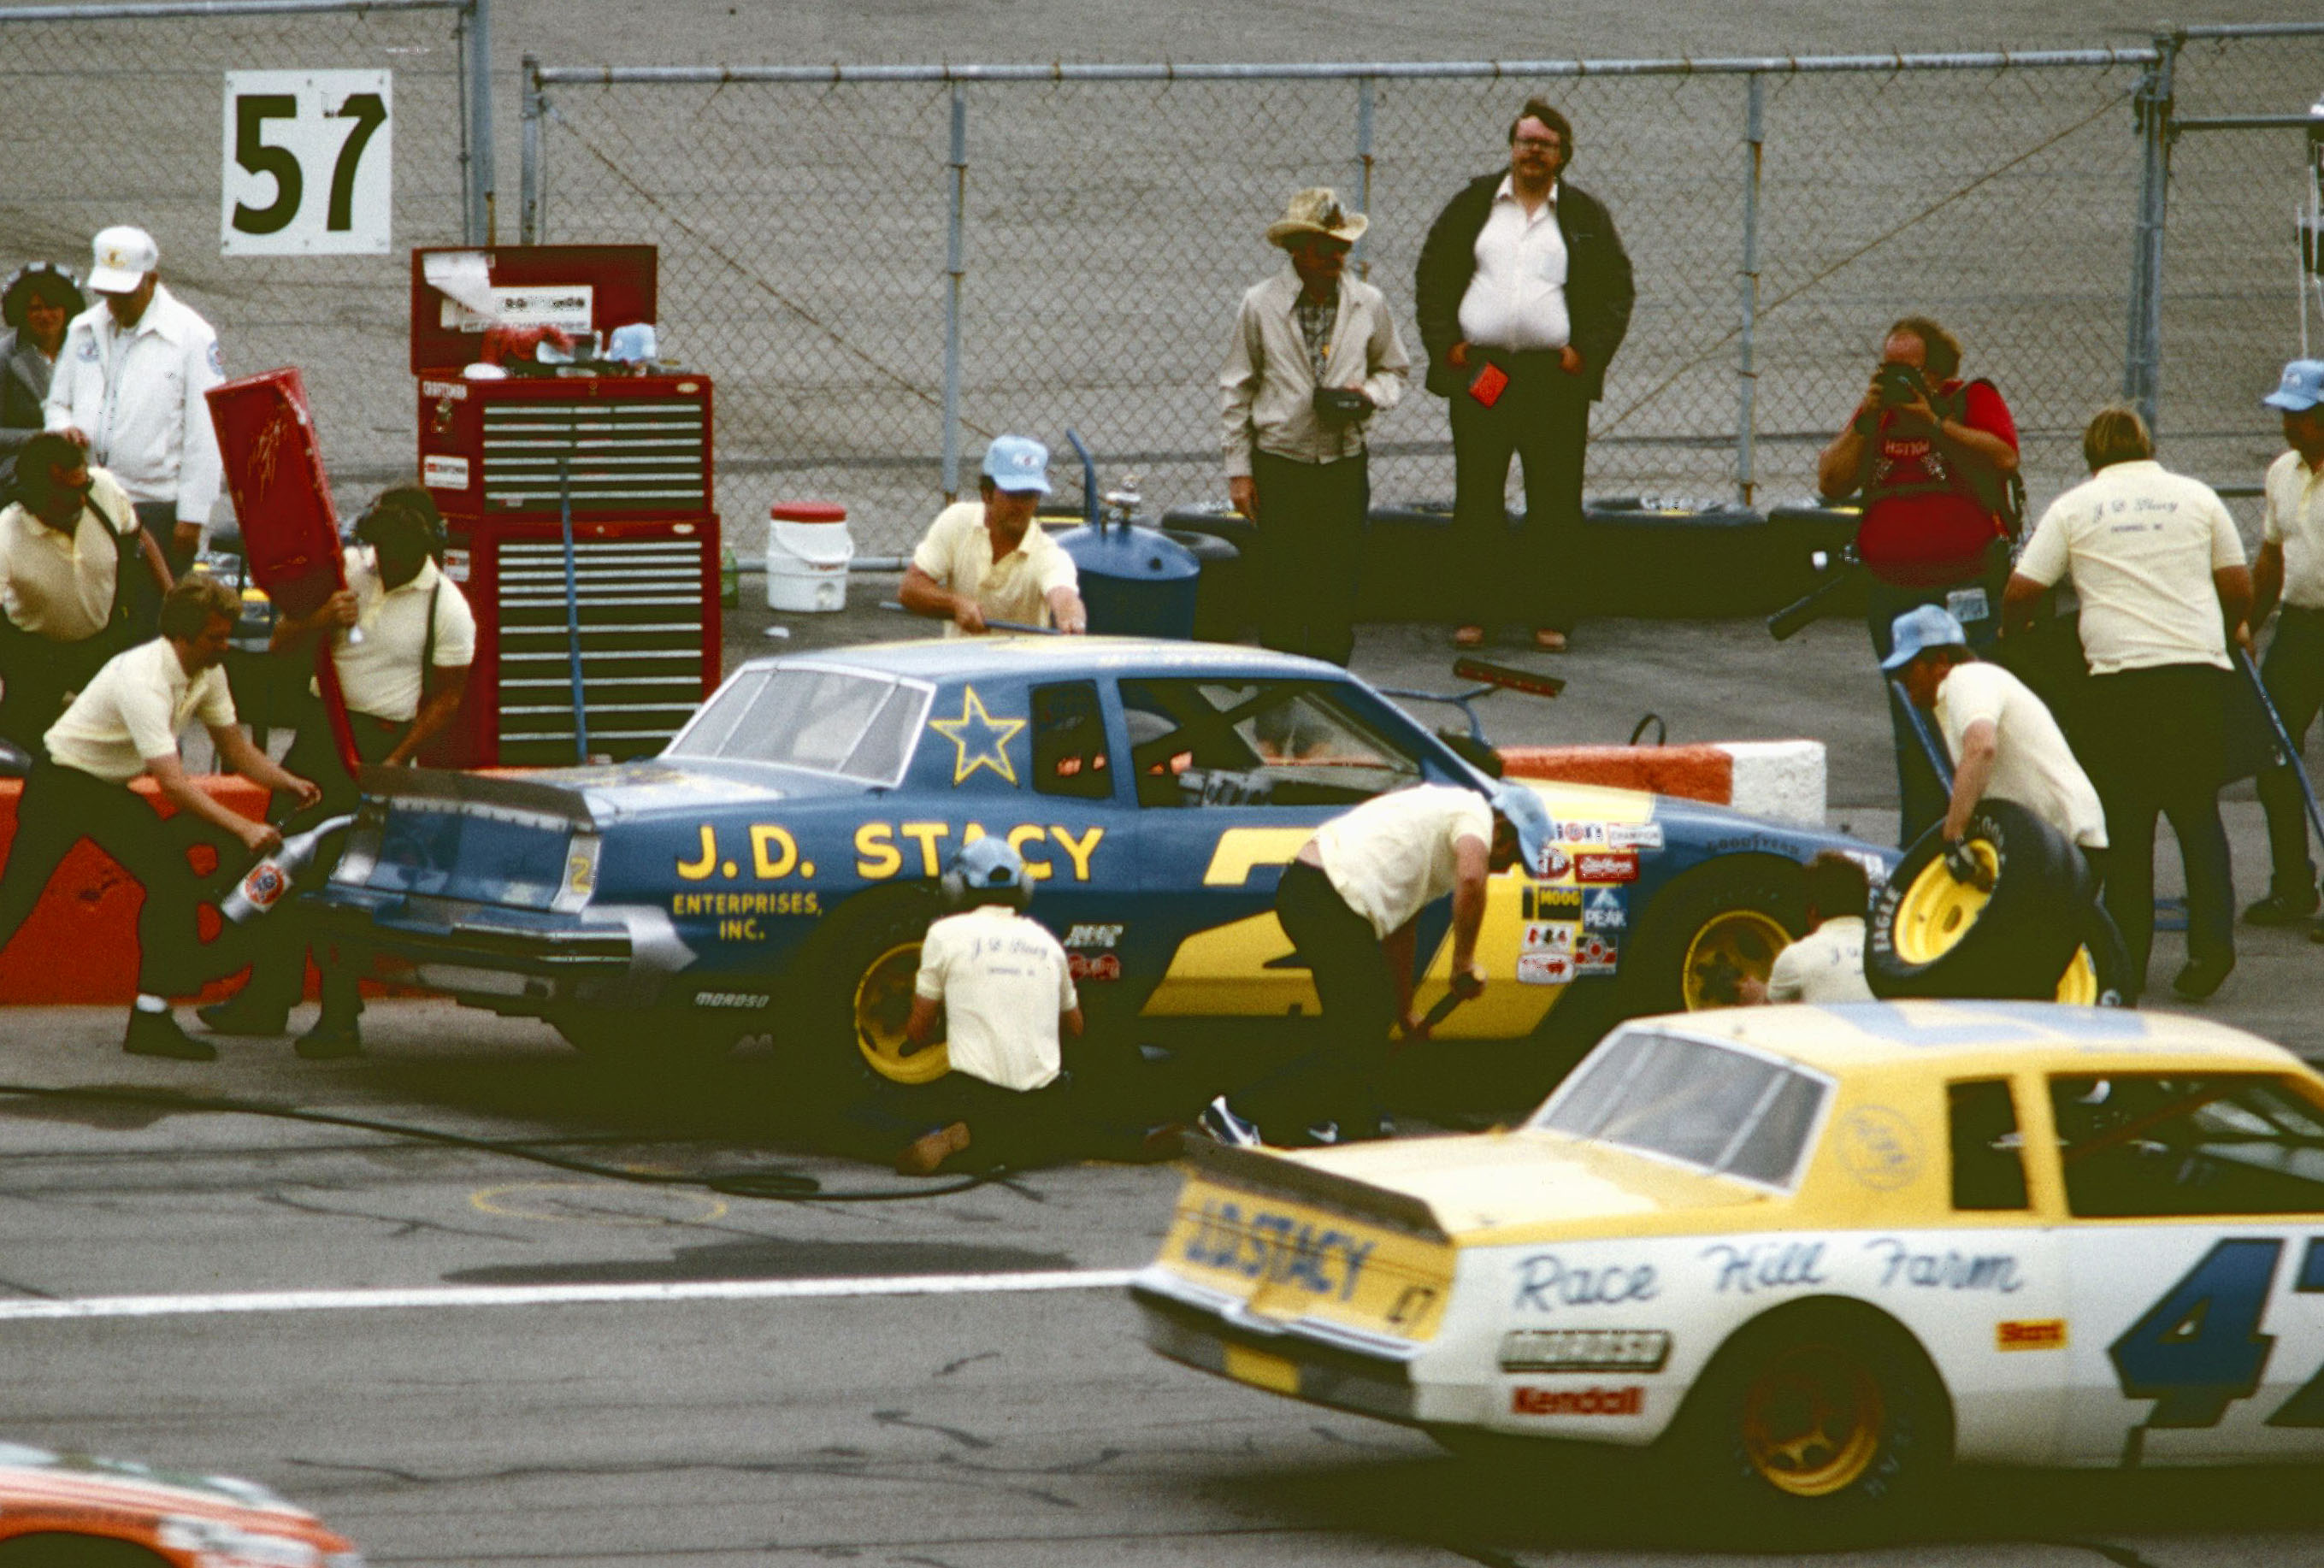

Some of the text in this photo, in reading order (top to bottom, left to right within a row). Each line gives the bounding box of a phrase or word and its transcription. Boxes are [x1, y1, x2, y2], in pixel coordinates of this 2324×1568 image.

[233, 93, 387, 234] 57
[676, 822, 1105, 881] J.D. STCY
[1707, 833, 1800, 855] GOODYEAR
[570, 858, 591, 893] 2
[673, 893, 823, 917] ENTERPRISES,
[1540, 888, 1581, 905] MOOG
[720, 919, 765, 940] INC.
[1585, 910, 1626, 927] PEAK
[693, 991, 770, 1009] MOROSO
[1513, 1236, 2024, 1312] Race Hill Farm
[2106, 1236, 2324, 1428] 4
[1512, 1386, 1644, 1415] Kendall
